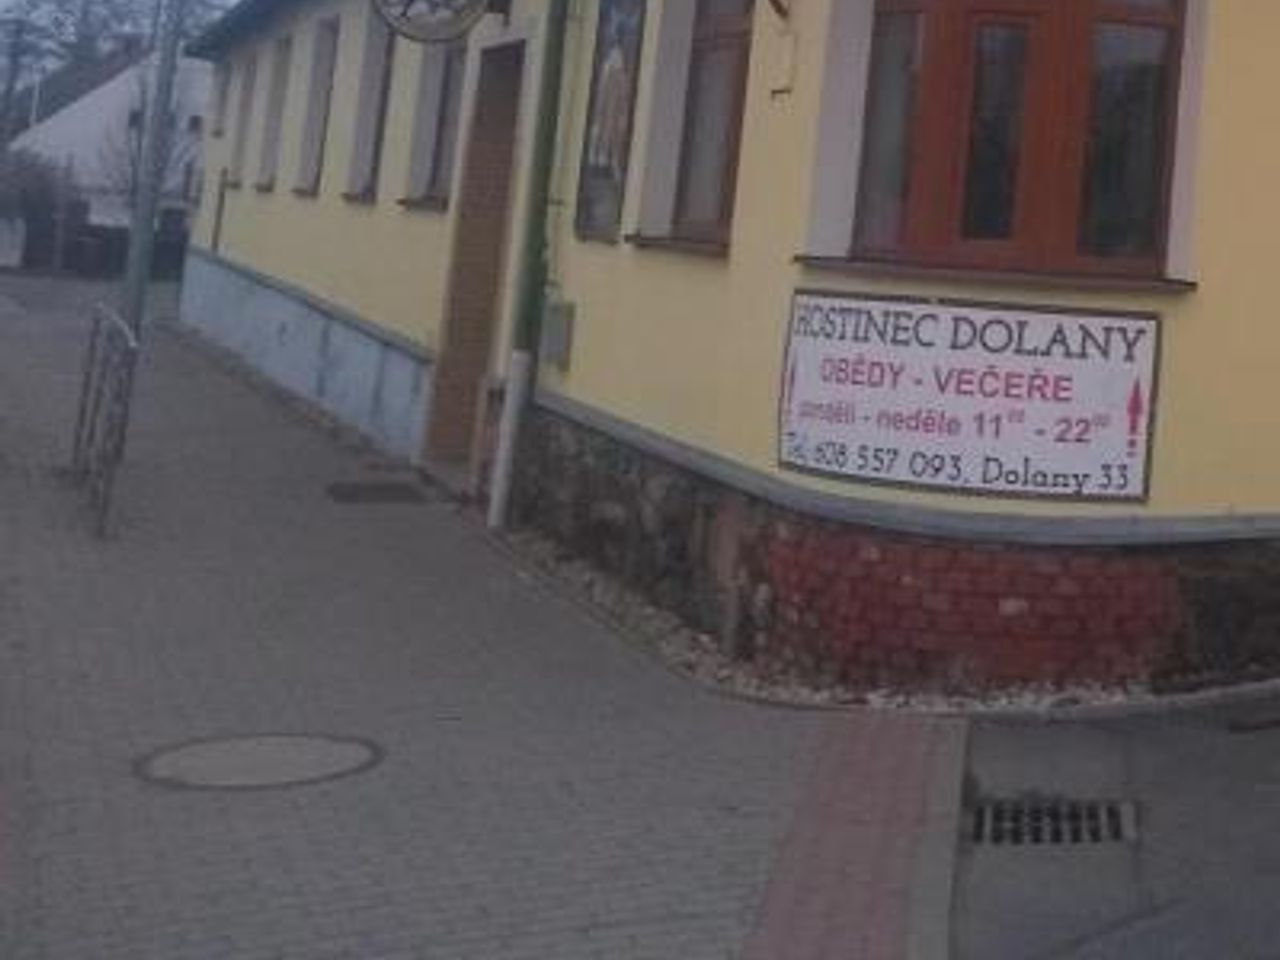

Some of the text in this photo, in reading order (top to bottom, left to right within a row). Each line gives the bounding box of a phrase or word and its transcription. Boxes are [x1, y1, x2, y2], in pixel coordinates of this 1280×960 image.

[794, 304, 1146, 362] HOSTINEC DOLANY
[821, 352, 905, 388] OBĚDY
[934, 360, 1073, 403] VEČEŘE
[876, 409, 962, 436] neděle
[857, 444, 899, 473] 557
[982, 455, 1091, 494] Dolany
[1098, 463, 1129, 489] 33
